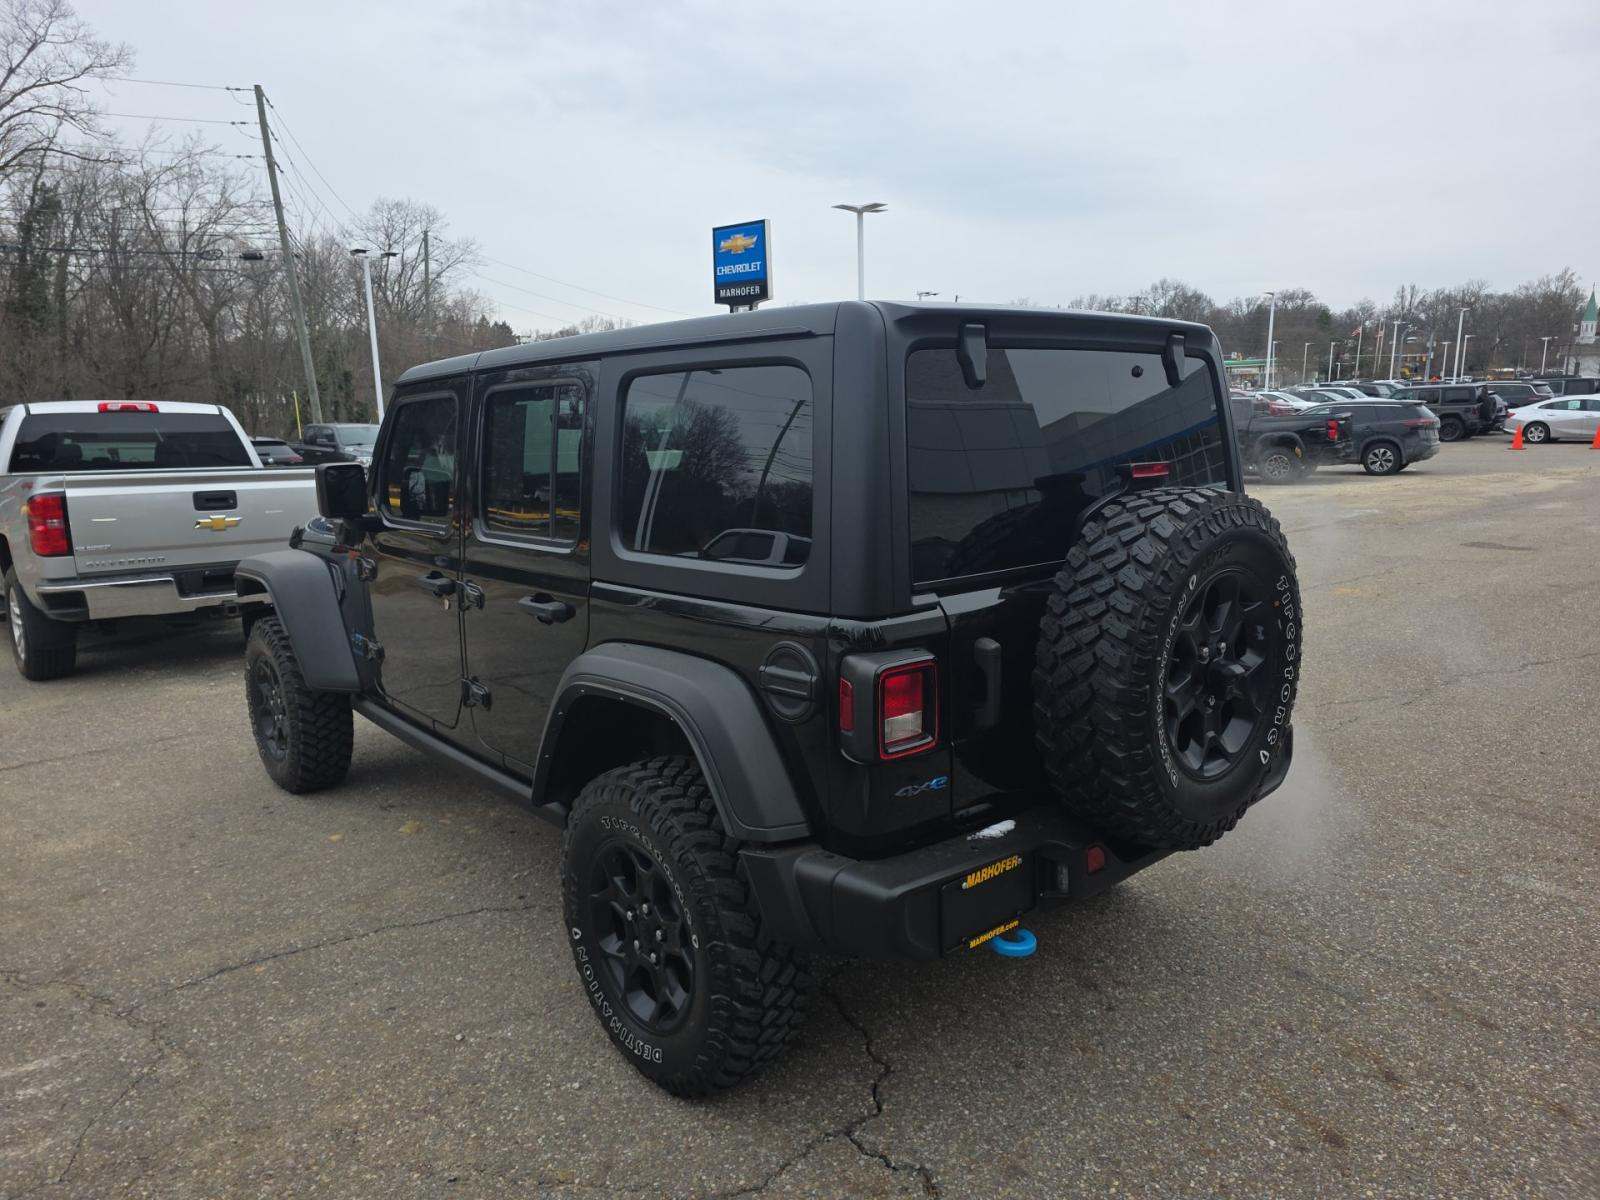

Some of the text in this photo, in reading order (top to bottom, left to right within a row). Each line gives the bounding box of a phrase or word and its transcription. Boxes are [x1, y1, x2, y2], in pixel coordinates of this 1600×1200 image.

[717, 261, 762, 276] CHEVROLET
[719, 285, 760, 298] MARHOFER
[966, 855, 1018, 889] MARHOFER
[969, 920, 1020, 949] MARHOFER.com
[577, 946, 663, 1063] DESTINATION
